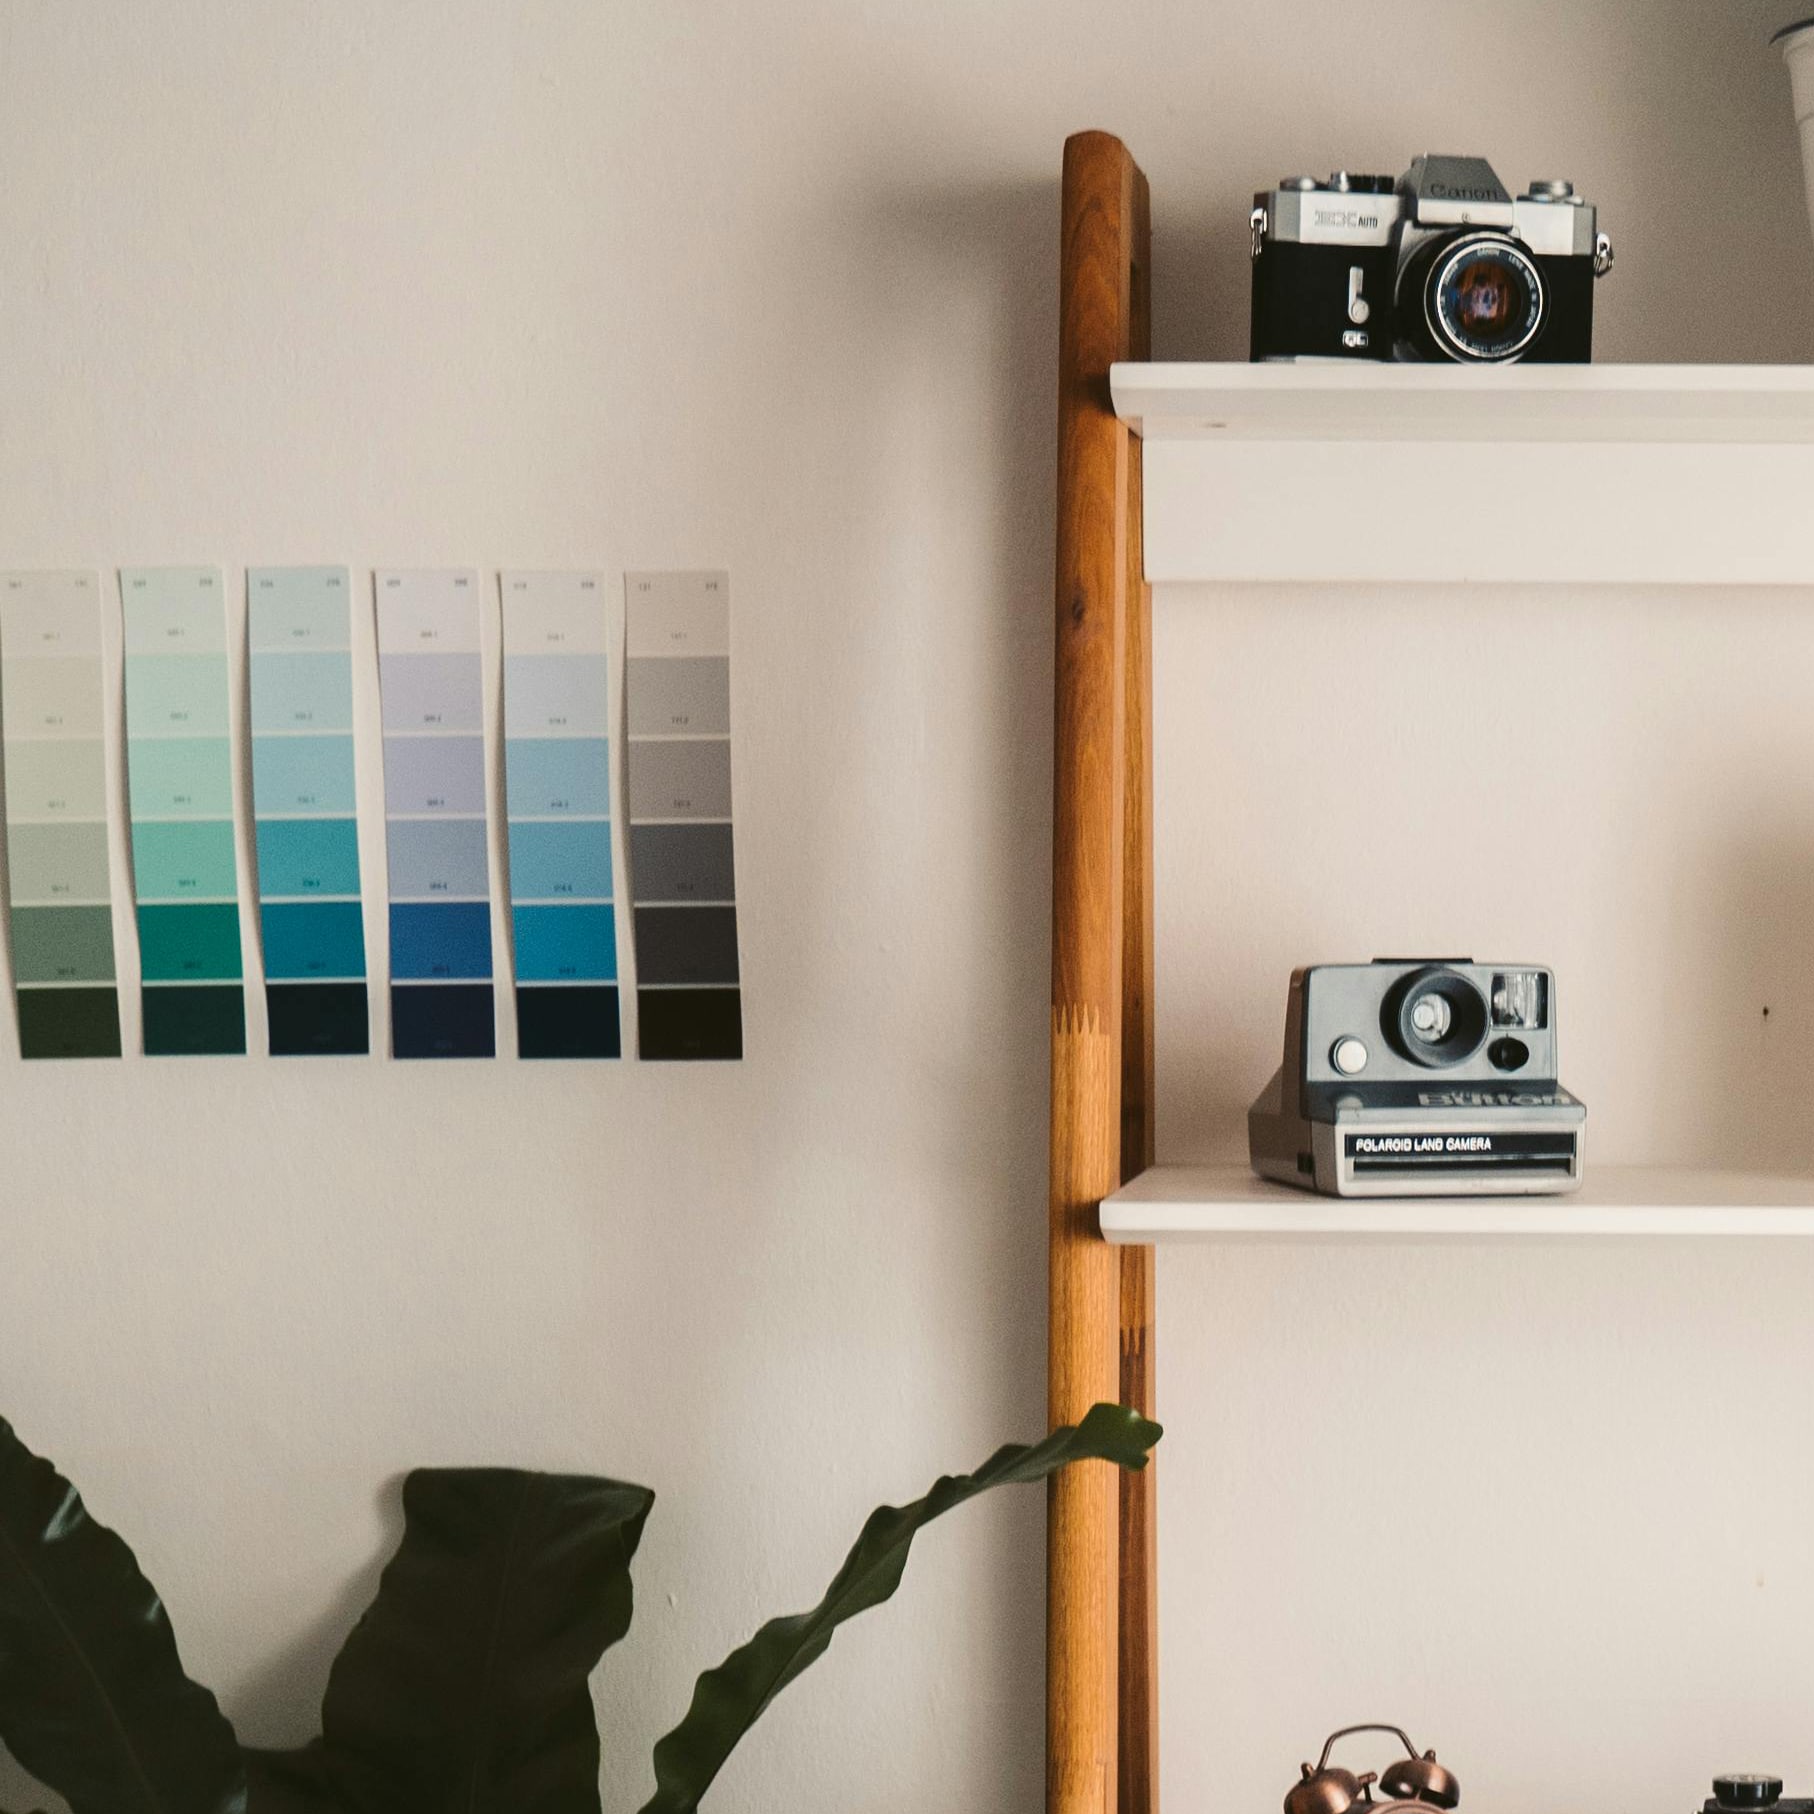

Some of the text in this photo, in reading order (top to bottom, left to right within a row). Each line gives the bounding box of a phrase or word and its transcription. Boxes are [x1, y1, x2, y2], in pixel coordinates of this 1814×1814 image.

[1430, 184, 1500, 200] Canon
[1358, 216, 1379, 229] AUTO
[1418, 1090, 1571, 1106] Button
[1355, 1136, 1492, 1152] POLAROID LAND CAMERA
